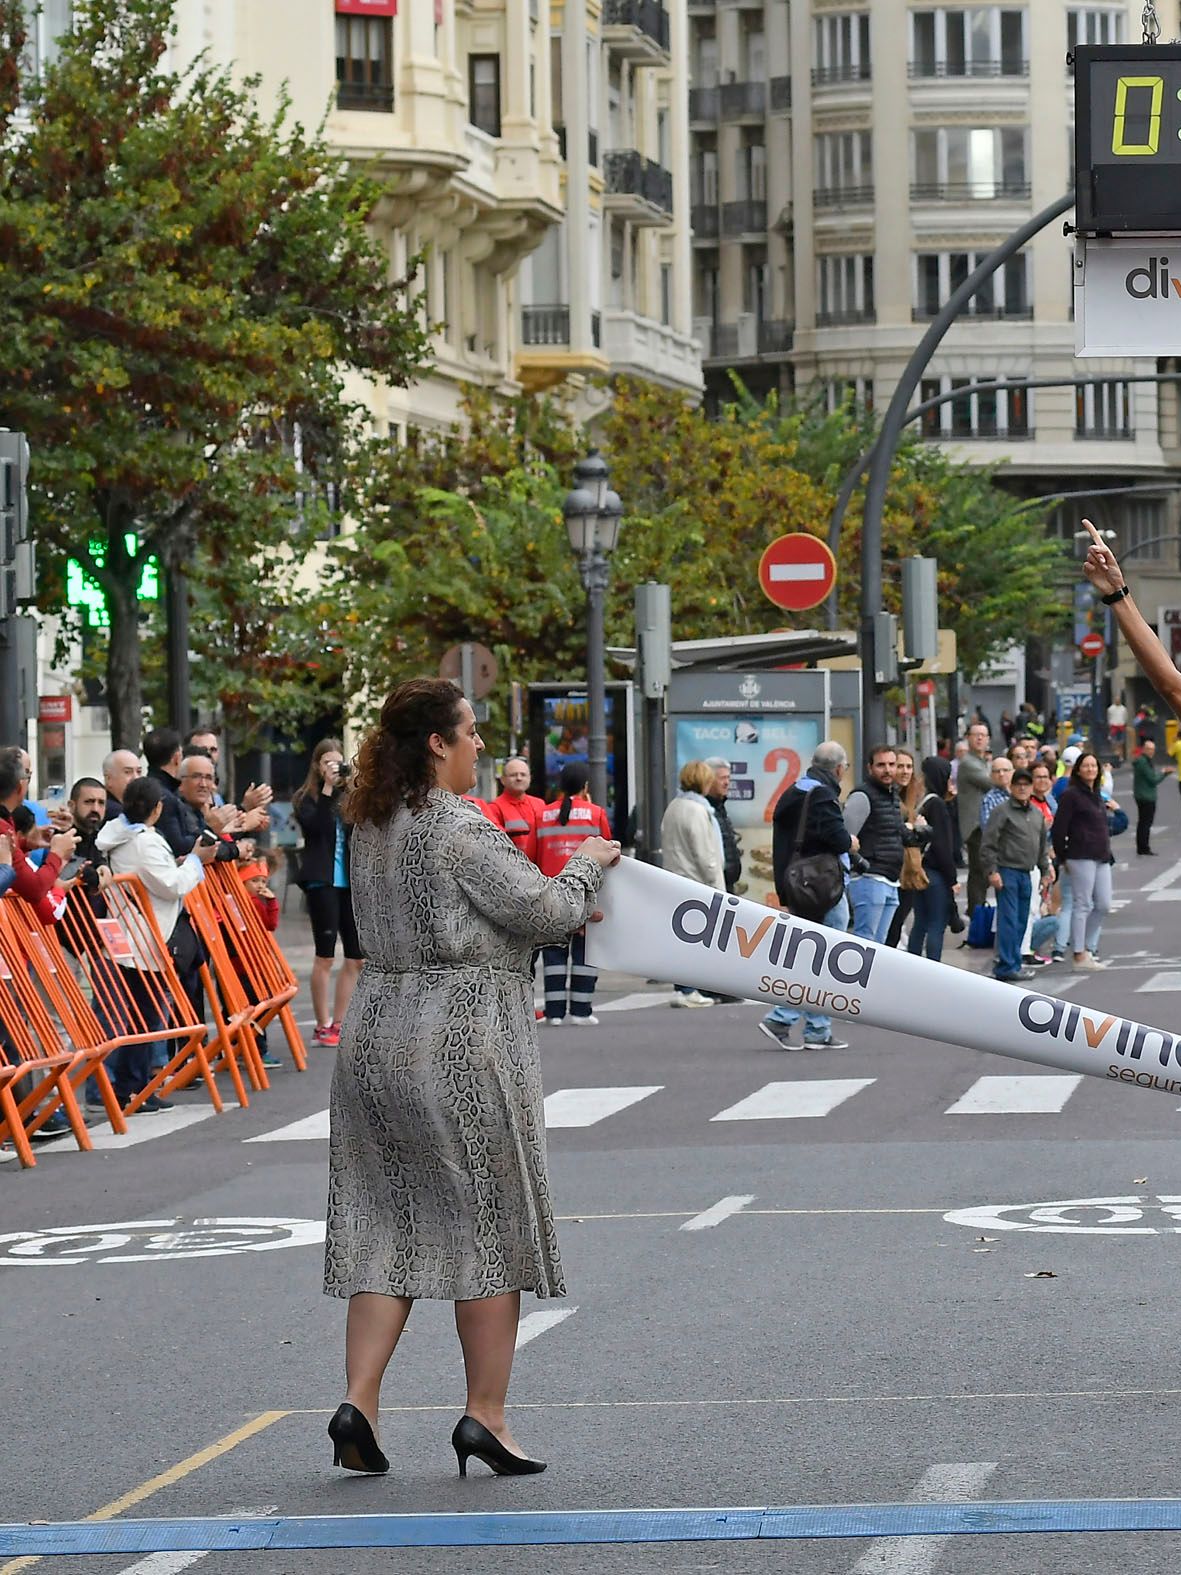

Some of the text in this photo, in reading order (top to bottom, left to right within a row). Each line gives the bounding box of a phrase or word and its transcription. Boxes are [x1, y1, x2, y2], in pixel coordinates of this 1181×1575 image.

[702, 700, 748, 708] AJUNTAMENT
[749, 700, 760, 708] DE
[692, 728, 731, 740] TACO
[671, 892, 877, 988] divina
[758, 975, 862, 1015] seguros
